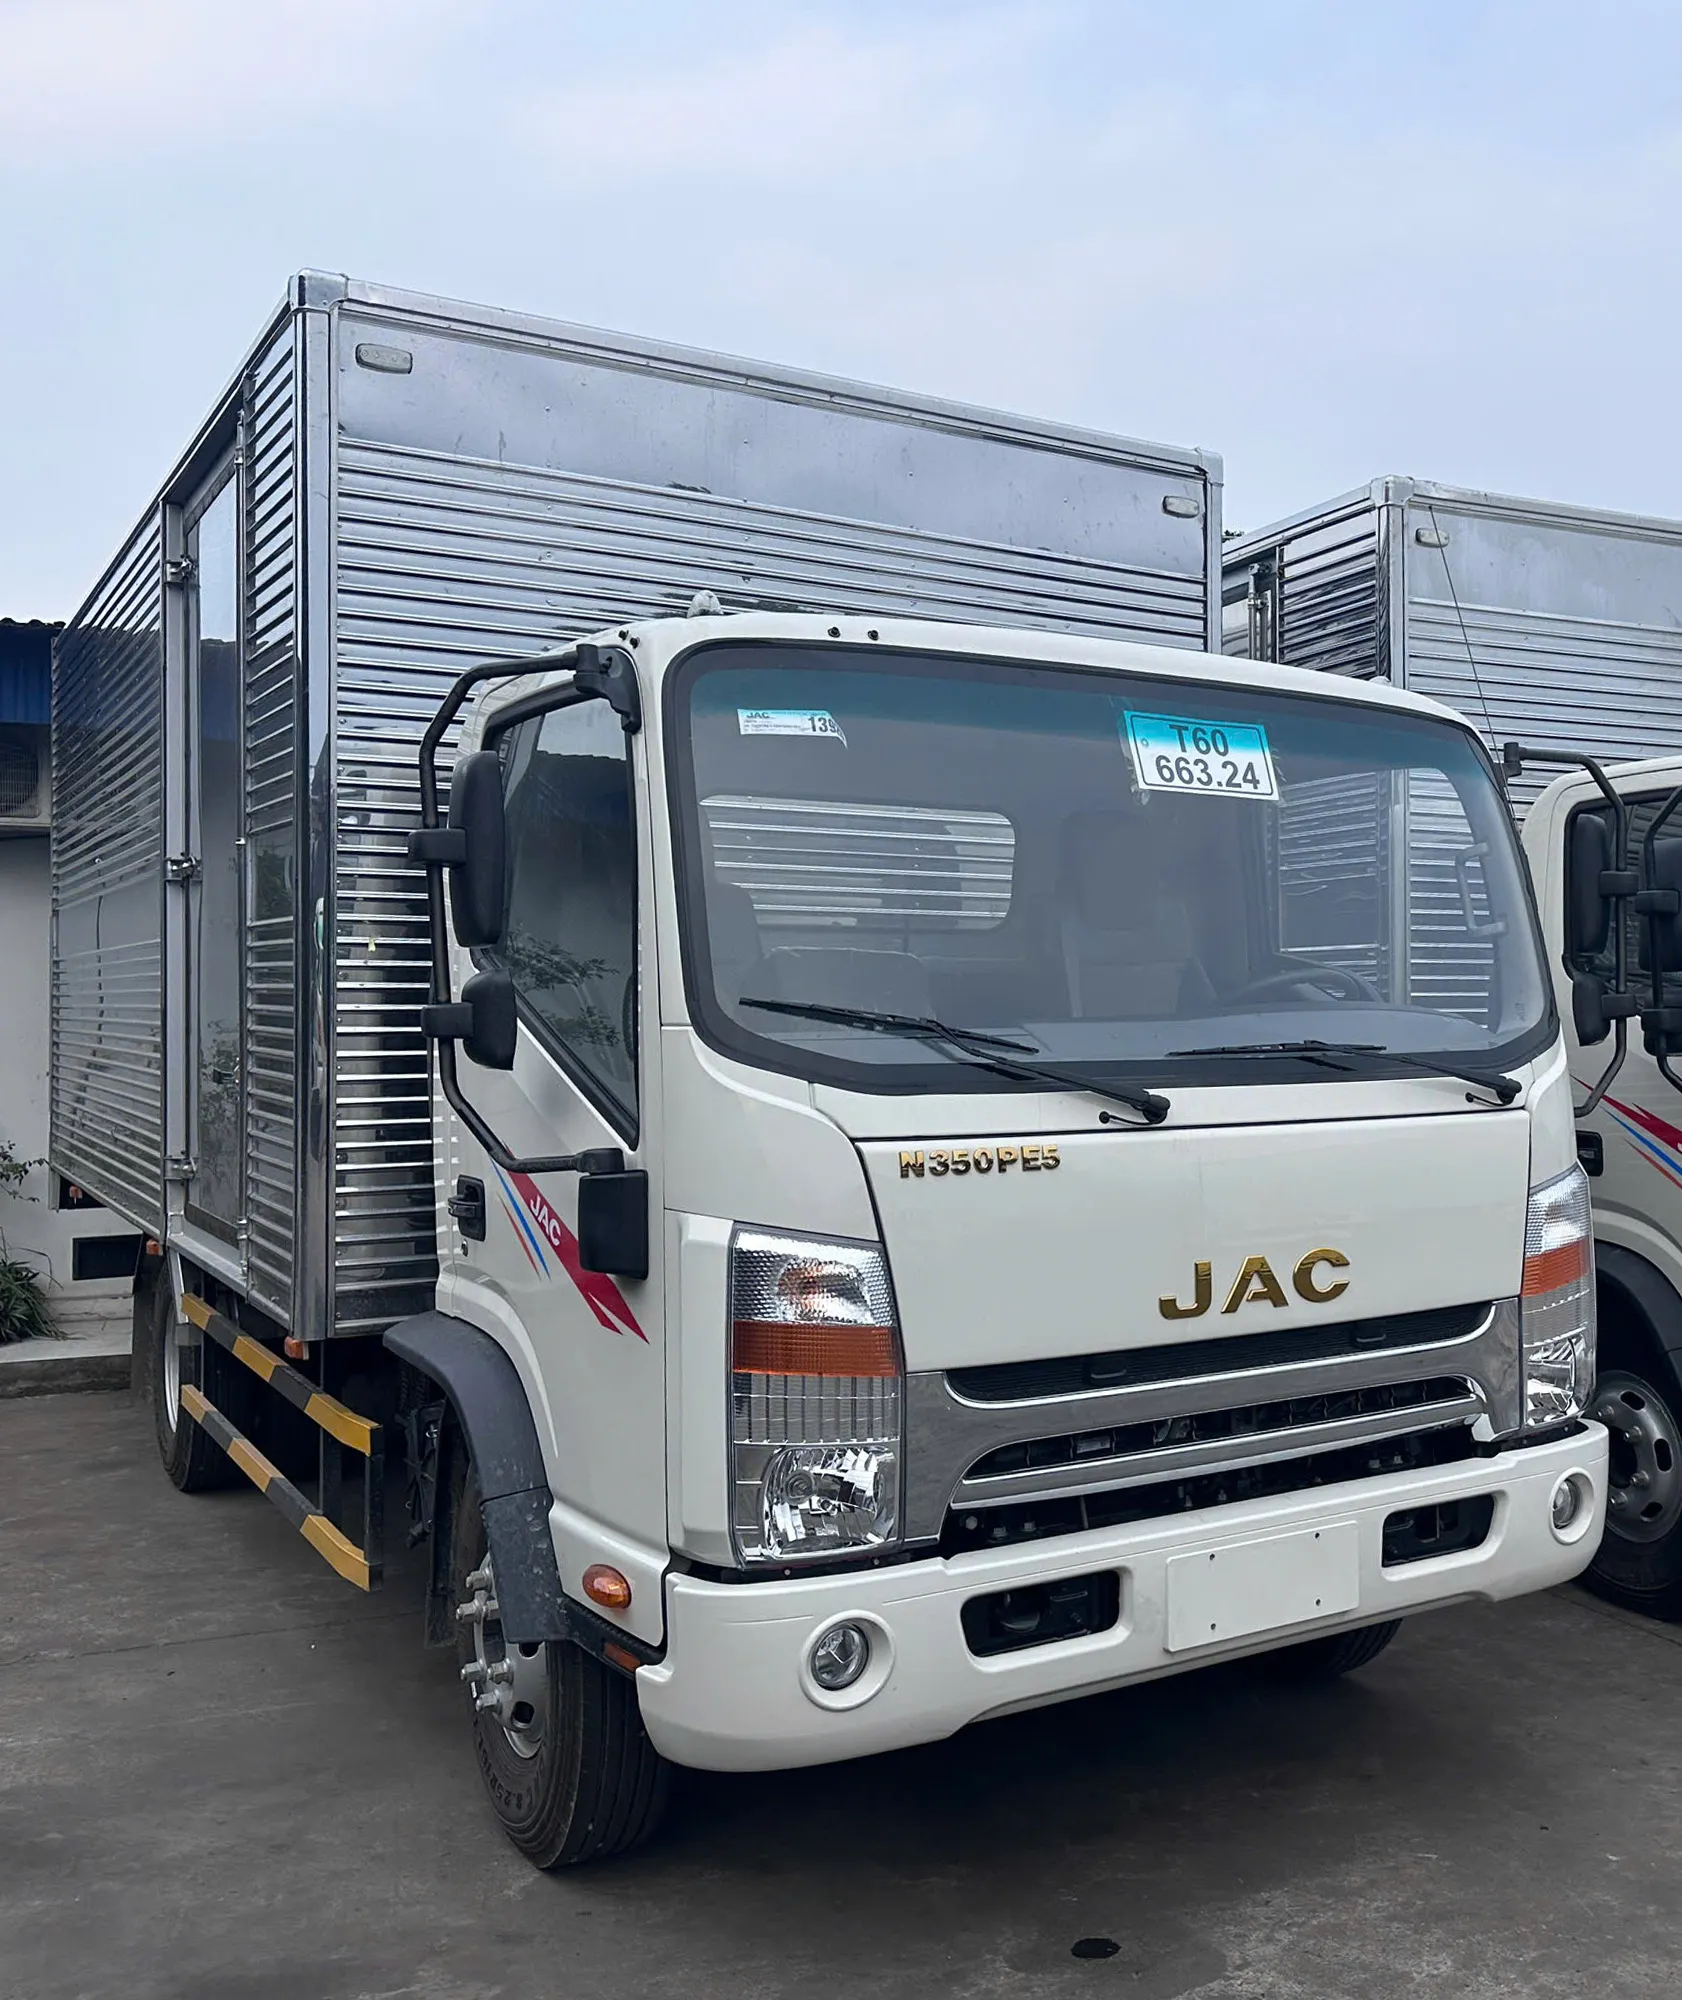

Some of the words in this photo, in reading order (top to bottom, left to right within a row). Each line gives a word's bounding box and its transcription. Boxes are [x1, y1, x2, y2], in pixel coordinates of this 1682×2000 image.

[746, 711, 770, 719] JAC
[1168, 724, 1230, 757] T60
[1155, 755, 1261, 790] 663.24
[898, 1144, 1061, 1179] N350PE5
[530, 1195, 561, 1247] JAC
[1159, 1247, 1351, 1320] JAC
